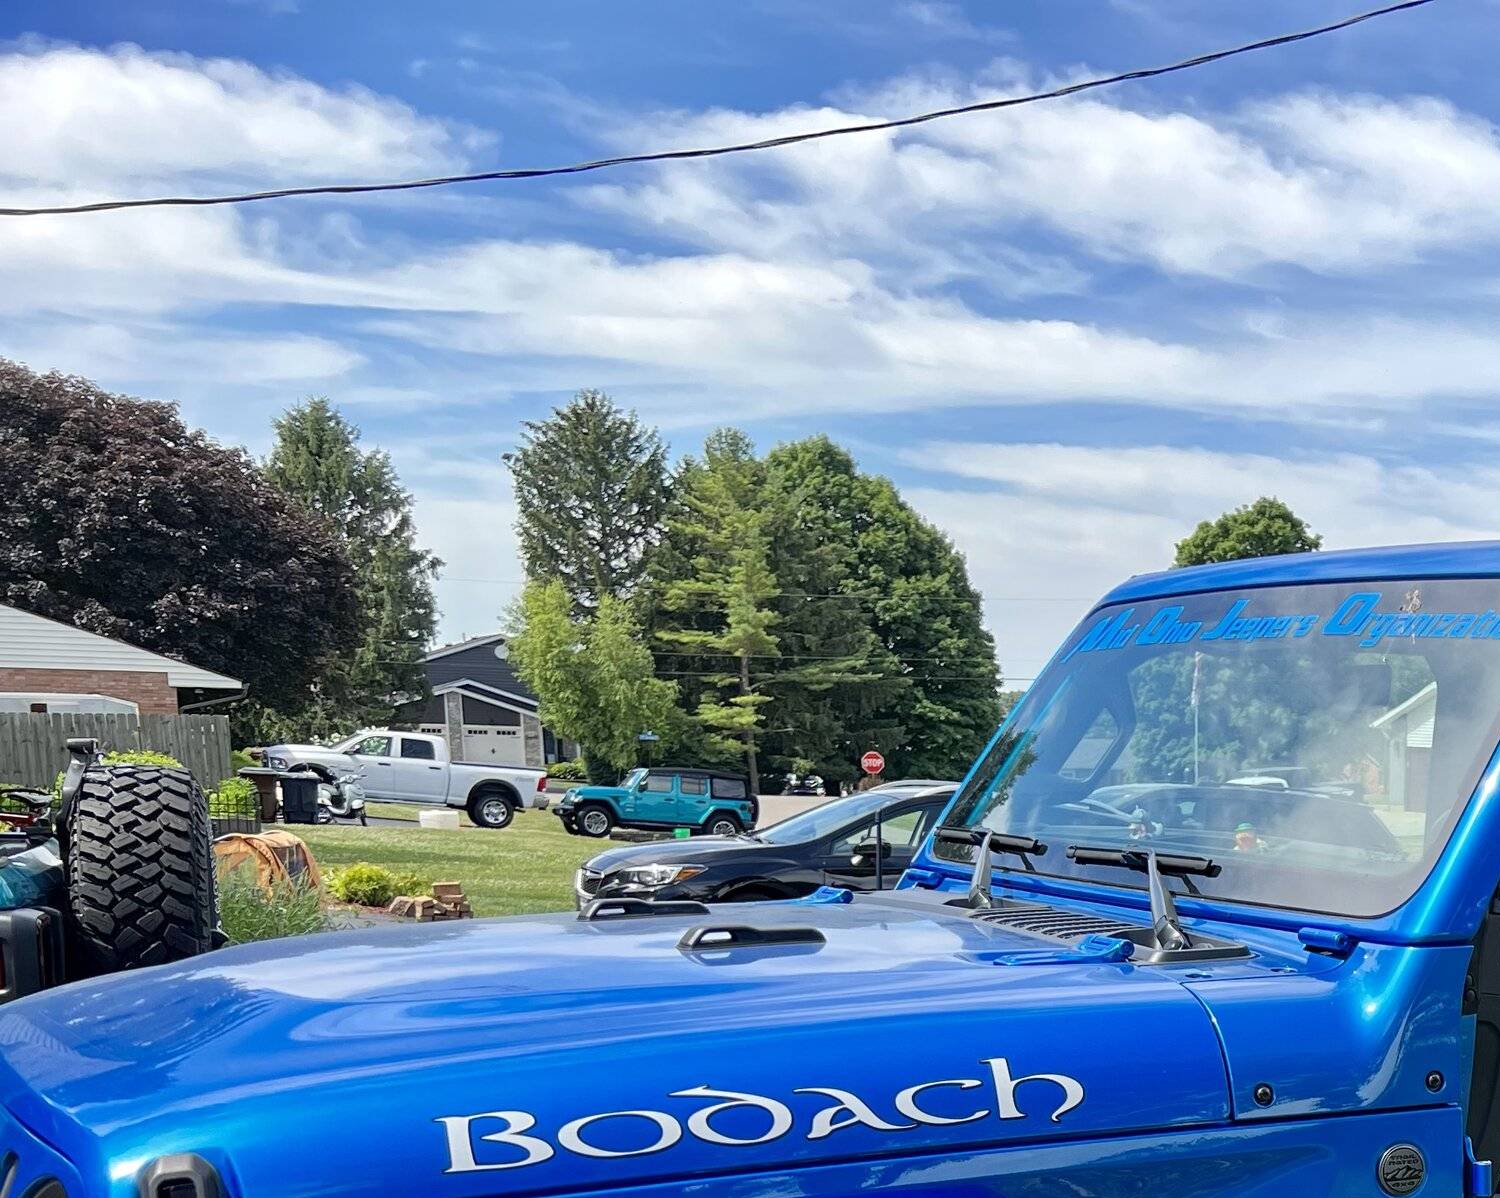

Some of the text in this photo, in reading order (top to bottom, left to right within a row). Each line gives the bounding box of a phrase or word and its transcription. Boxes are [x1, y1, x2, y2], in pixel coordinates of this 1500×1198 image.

[1136, 605, 1202, 645] Ohio
[1200, 599, 1319, 645] Jeepers
[863, 758, 883, 768] STOP
